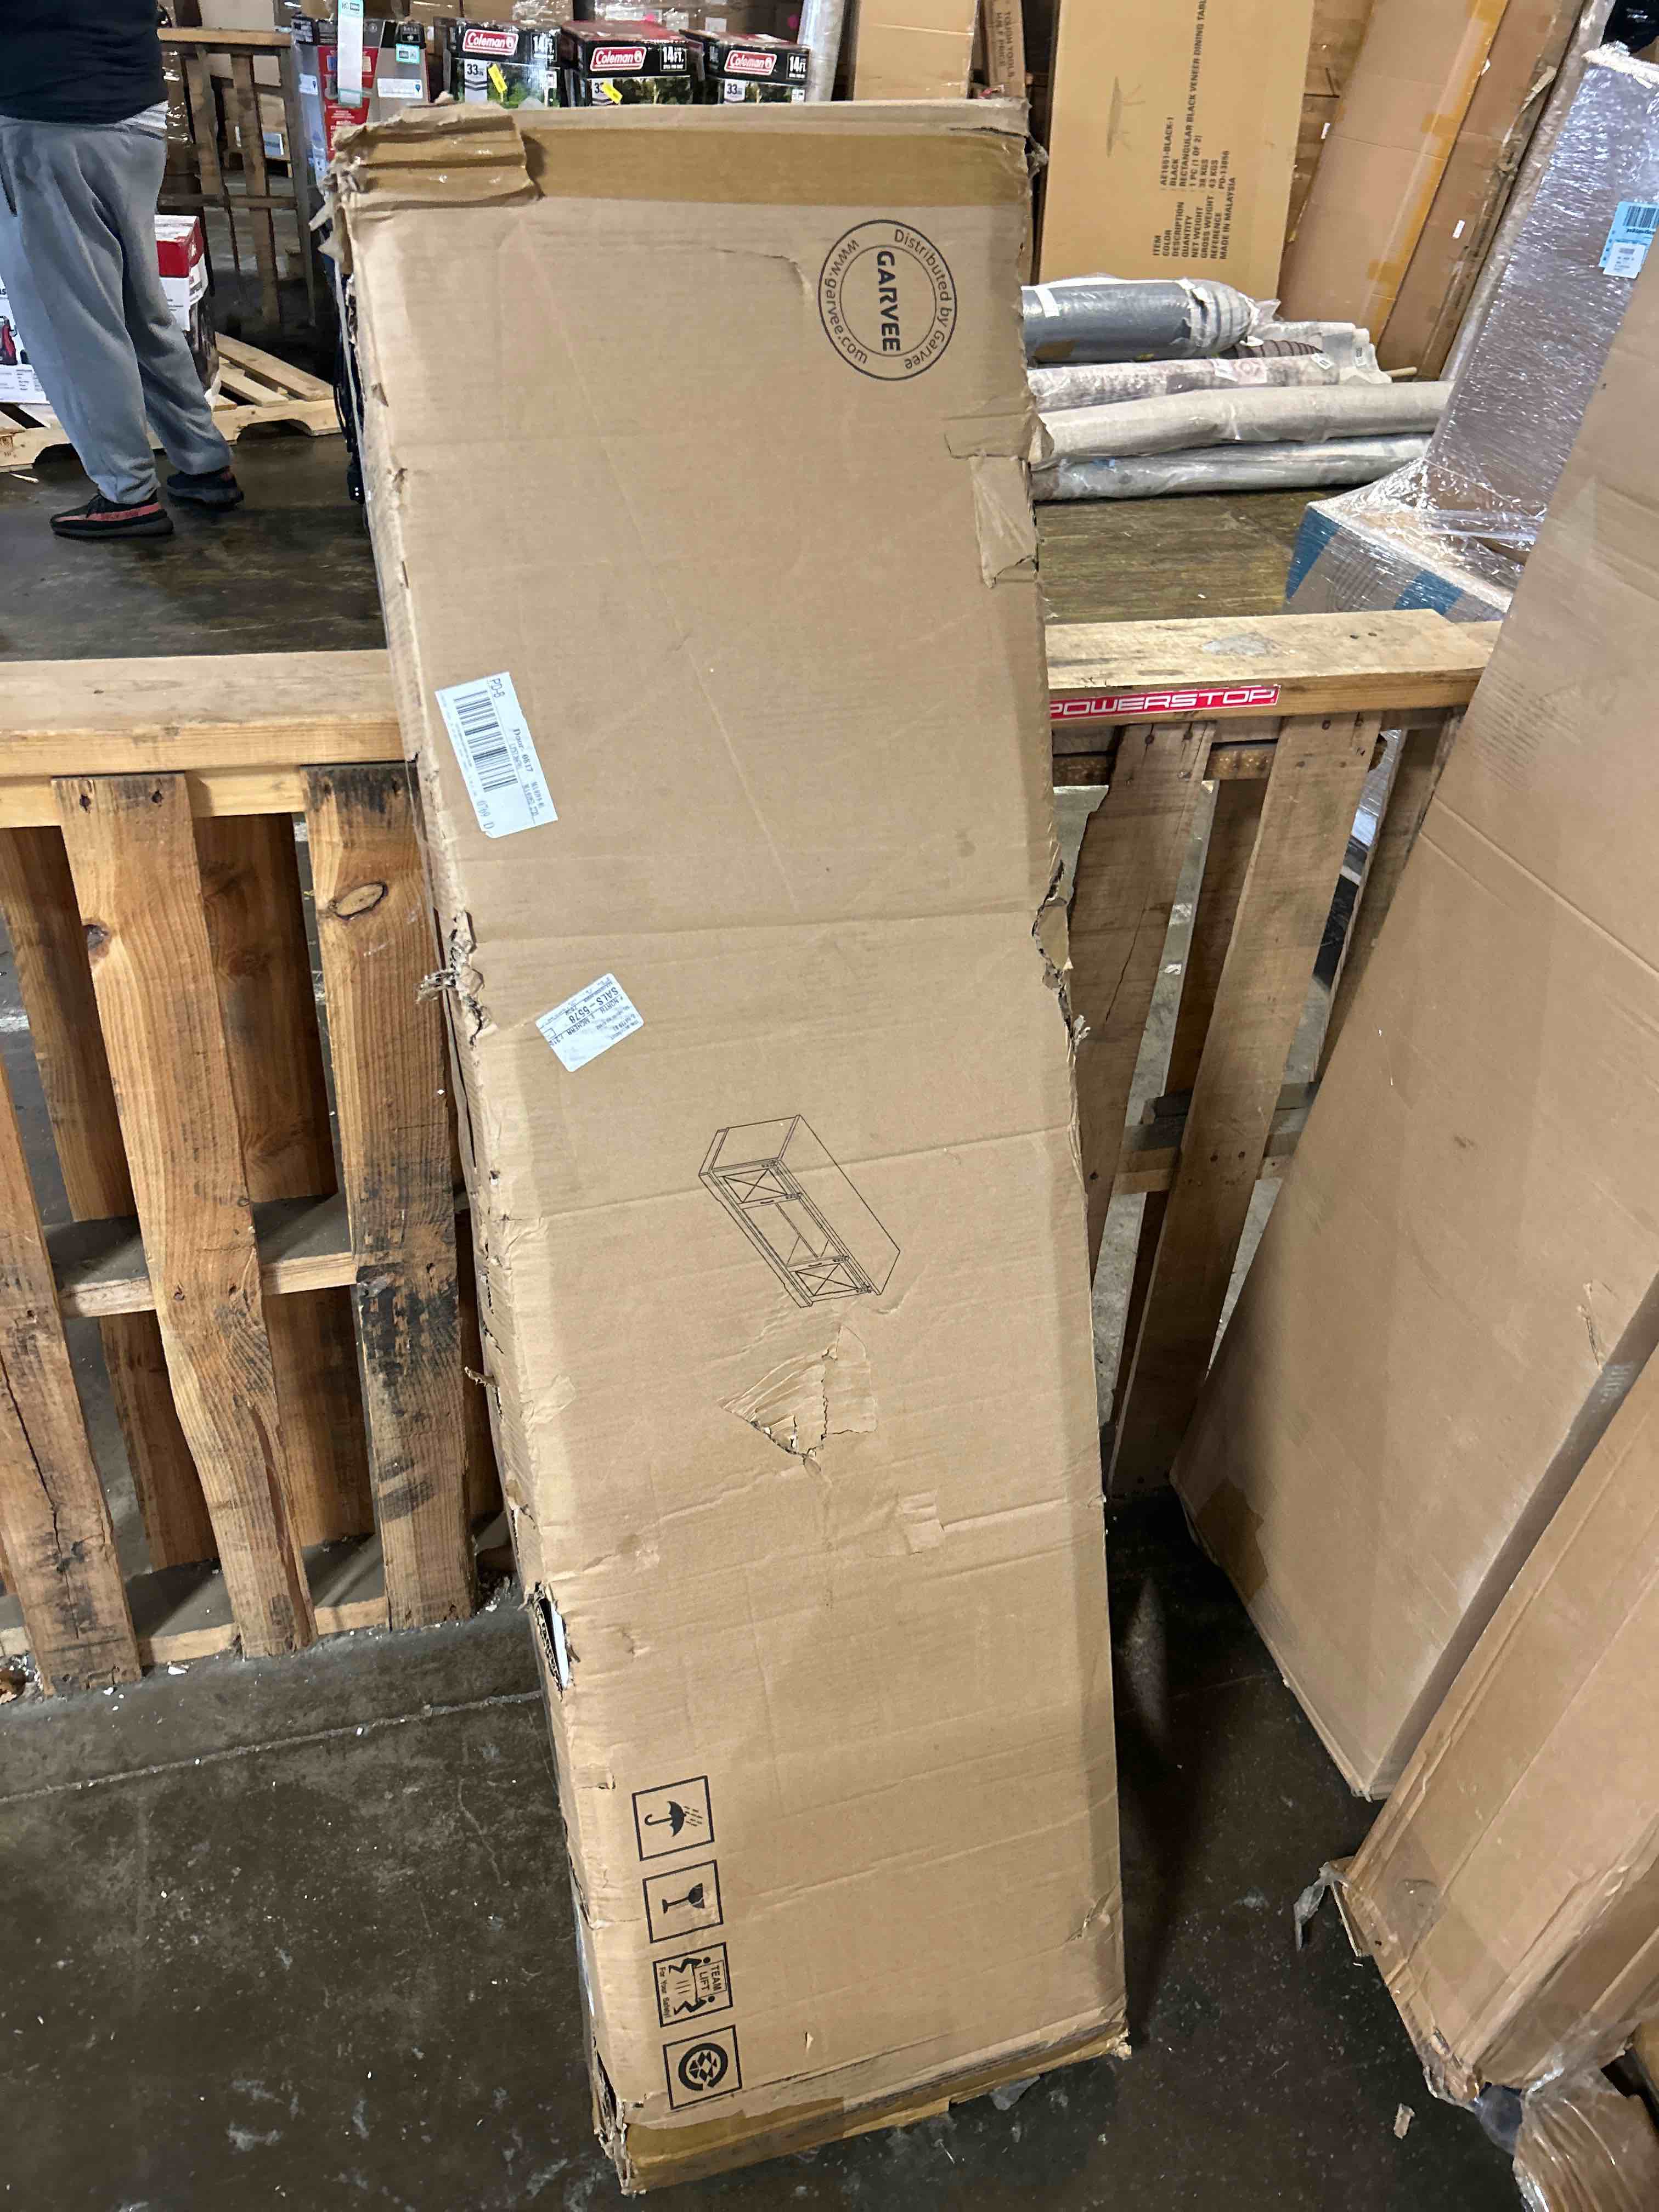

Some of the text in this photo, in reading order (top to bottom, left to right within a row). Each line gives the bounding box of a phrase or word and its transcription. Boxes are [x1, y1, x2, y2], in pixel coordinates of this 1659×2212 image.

[467, 32, 505, 49] Coleman
[1193, 24, 1205, 56] DINING
[466, 63, 479, 76] 33
[595, 50, 634, 65] Coleman
[730, 53, 764, 69] Coleman
[726, 83, 737, 94] 33
[1189, 58, 1201, 93] VENEER
[1186, 94, 1197, 123] BLACK
[1180, 125, 1194, 187] RECTANGULAR
[1193, 146, 1200, 156] OF
[1190, 168, 1198, 180] PC
[1200, 159, 1209, 176] KGS
[1210, 159, 1218, 177] KGS
[1163, 158, 1179, 257] COLOR BLACK
[1204, 195, 1215, 229] WEIGHT
[1219, 177, 1236, 259] MADE IN MALAYSIA
[1171, 201, 1184, 257] DESCRIPTION
[1193, 206, 1203, 240] WEIGHT
[1210, 212, 1222, 259] REFERENCE
[1153, 235, 1161, 256] ITEM
[1181, 216, 1193, 258] QUANTITY
[1191, 241, 1199, 258] NET
[1200, 230, 1210, 259] GROSS
[824, 239, 868, 365] www.garvee.com
[877, 251, 901, 352] GARVEE
[894, 229, 953, 369] Distributed by Garvee
[1049, 689, 1275, 715] POWERSTOP
[596, 986, 619, 1006] SALS
[568, 1006, 590, 1024] 5578
[699, 1971, 710, 1990] LIFT
[710, 1965, 722, 1991] TEAM
[662, 1996, 672, 2019] Safety!
